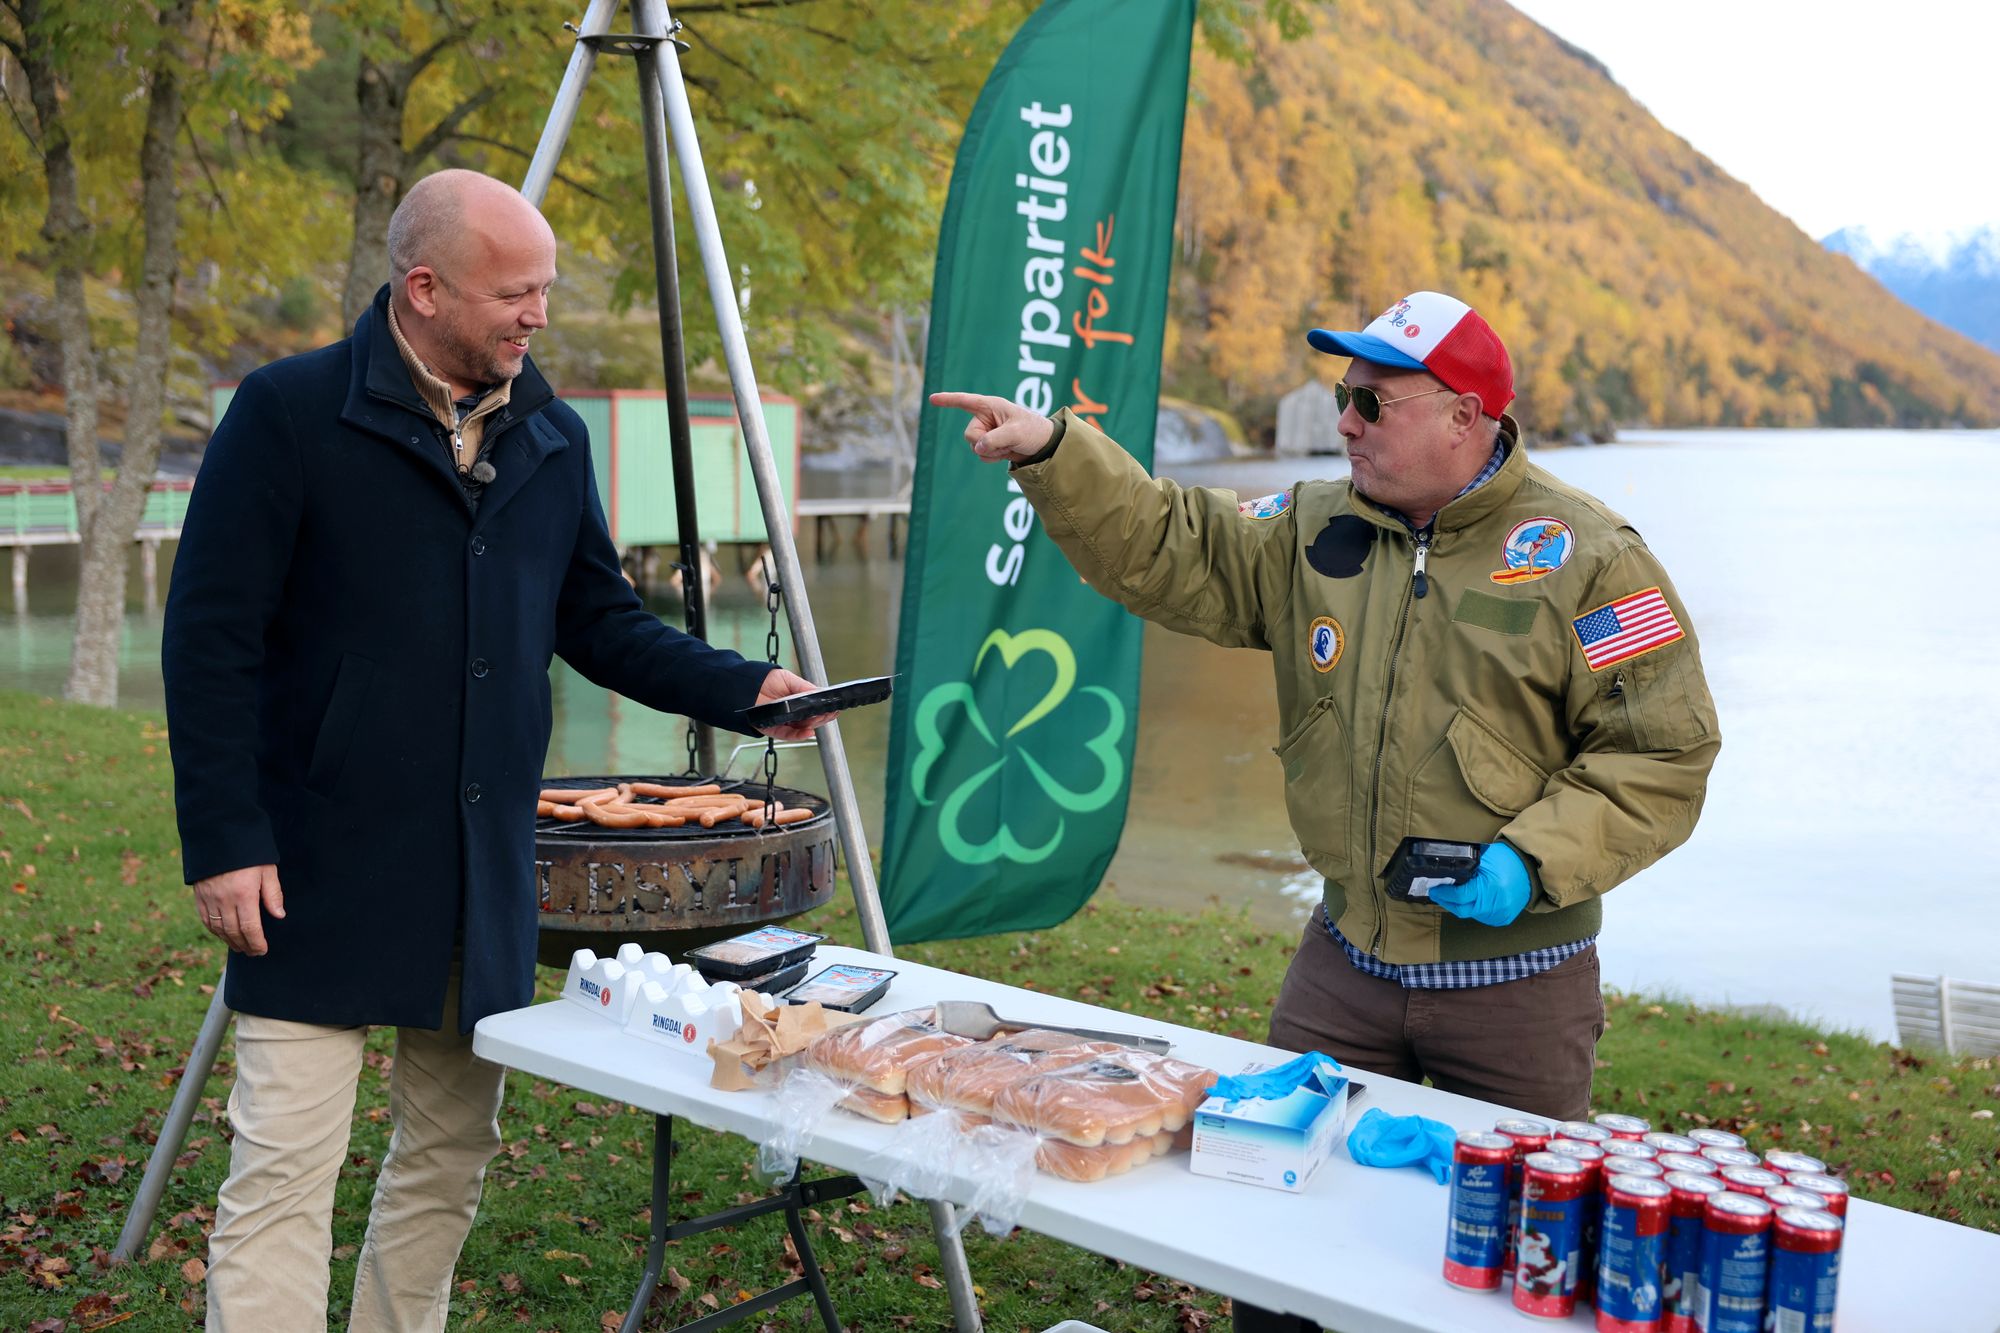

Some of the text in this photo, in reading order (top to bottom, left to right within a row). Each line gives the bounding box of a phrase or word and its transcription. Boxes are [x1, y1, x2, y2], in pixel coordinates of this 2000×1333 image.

[1073, 213, 1134, 348] folk
[985, 101, 1072, 586] Seerpartiet
[580, 977, 601, 998] RINGDAL
[652, 1014, 682, 1035] RINGDAL
